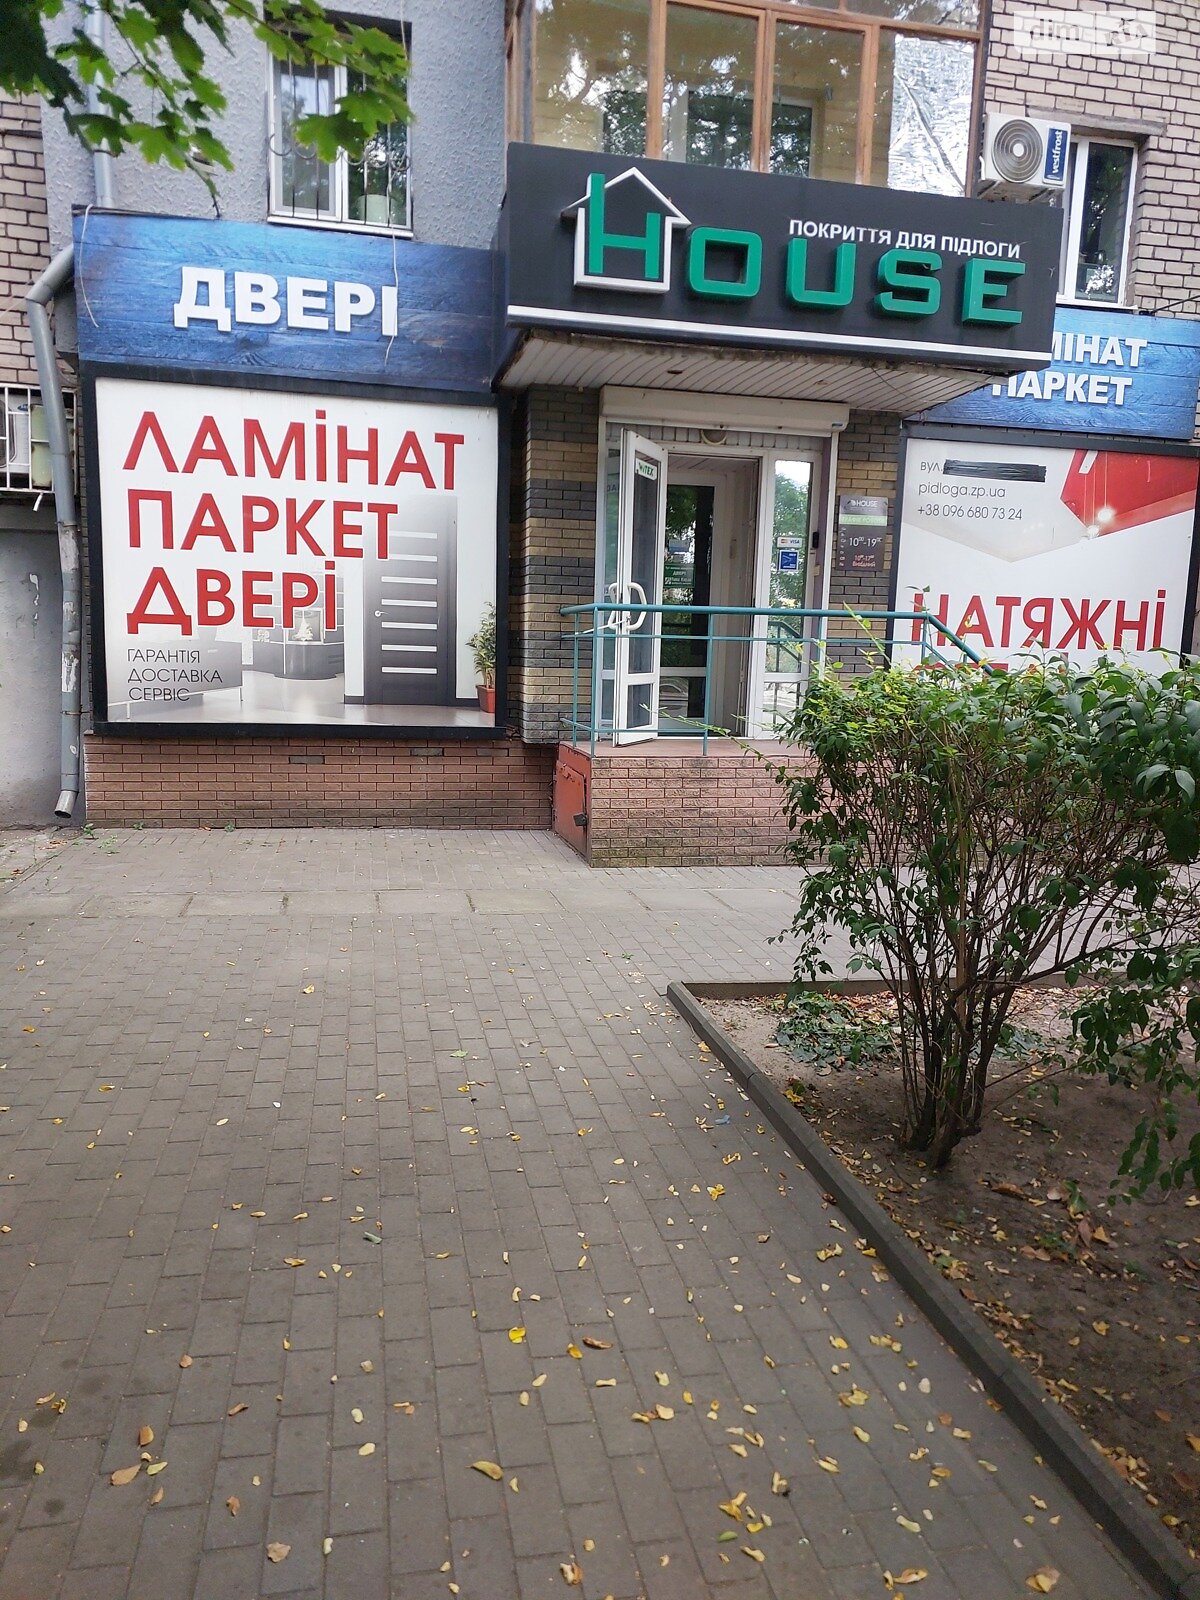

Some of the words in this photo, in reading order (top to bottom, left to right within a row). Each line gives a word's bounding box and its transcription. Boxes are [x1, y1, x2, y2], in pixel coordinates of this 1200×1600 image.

[1052, 130, 1063, 174] vestfrost
[587, 172, 1027, 325] HOUSE
[789, 218, 891, 245] ПОКРИТТЯ
[896, 231, 936, 250] ДЛЯ
[941, 235, 1021, 259] ПІДЛОГИ
[173, 266, 398, 337] ДВЕРІ
[123, 409, 464, 490] ЛАМІНАТ
[920, 461, 943, 474] вул.
[918, 481, 1006, 499] pidloga.zp.ua
[127, 488, 398, 559] ПАРКЕТ
[917, 506, 940, 517] +38
[942, 506, 964, 518] 096
[967, 507, 989, 518] 680
[992, 508, 1007, 520] 73
[1008, 508, 1022, 520] 24
[126, 560, 337, 636] ДВЕРІ
[911, 589, 1167, 651] НАТЯЖНІ
[127, 648, 201, 664] ГАРАНТІЯ
[127, 668, 223, 684] ДОСТАВКА
[128, 687, 190, 703] СЕРВІС
